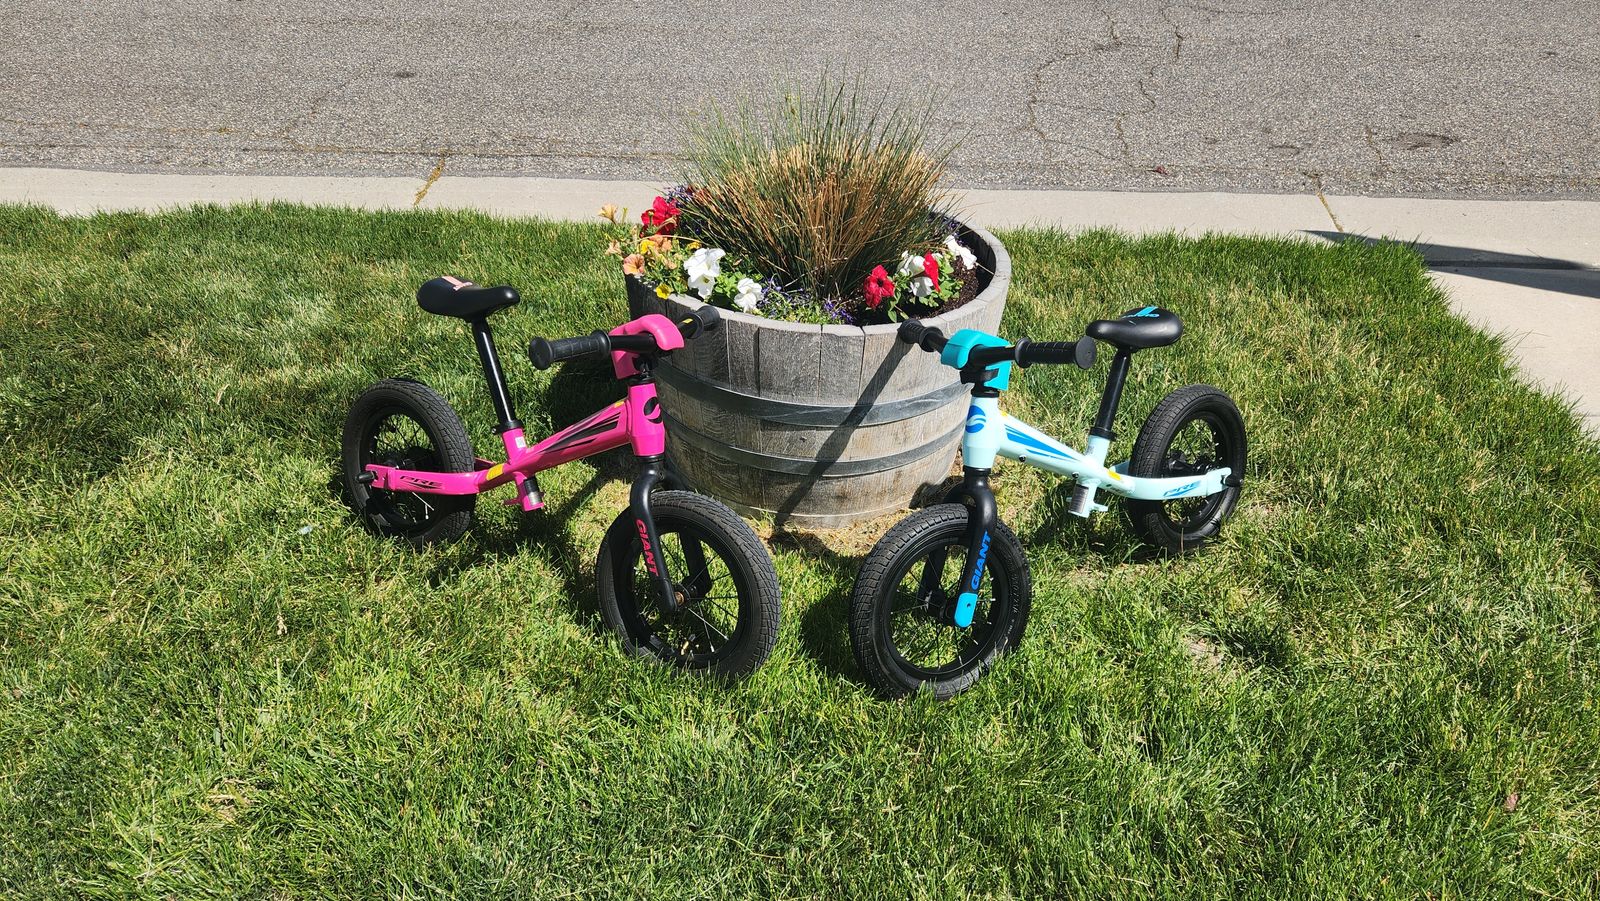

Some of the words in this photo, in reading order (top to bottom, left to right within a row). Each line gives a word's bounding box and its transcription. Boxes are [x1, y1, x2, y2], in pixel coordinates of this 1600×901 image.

[400, 475, 443, 488] PRE
[636, 519, 658, 576] GIANT
[971, 530, 991, 590] GIANT
